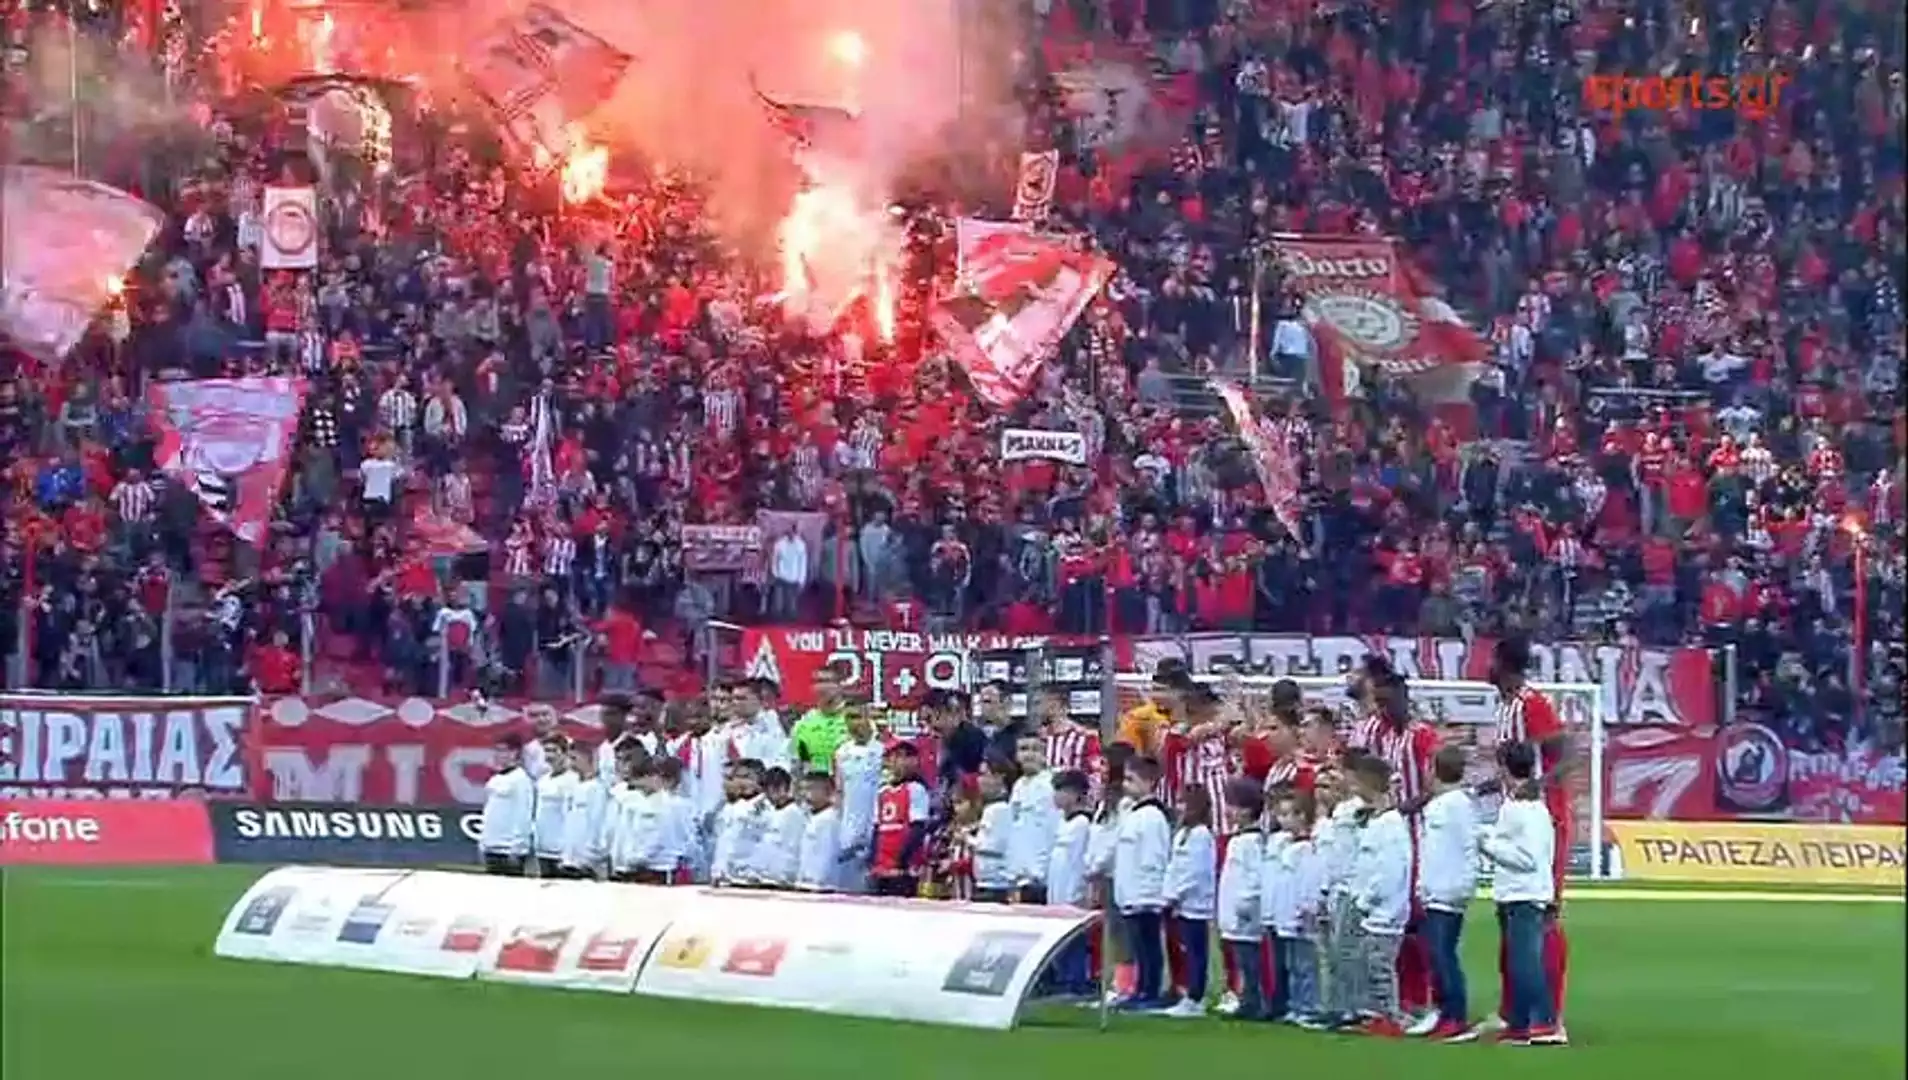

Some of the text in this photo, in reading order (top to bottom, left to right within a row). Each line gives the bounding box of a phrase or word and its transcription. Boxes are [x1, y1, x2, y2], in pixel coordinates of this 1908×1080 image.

[785, 631, 823, 651] YOU
[863, 630, 924, 652] NEVER
[235, 810, 443, 838] SAMSUNG
